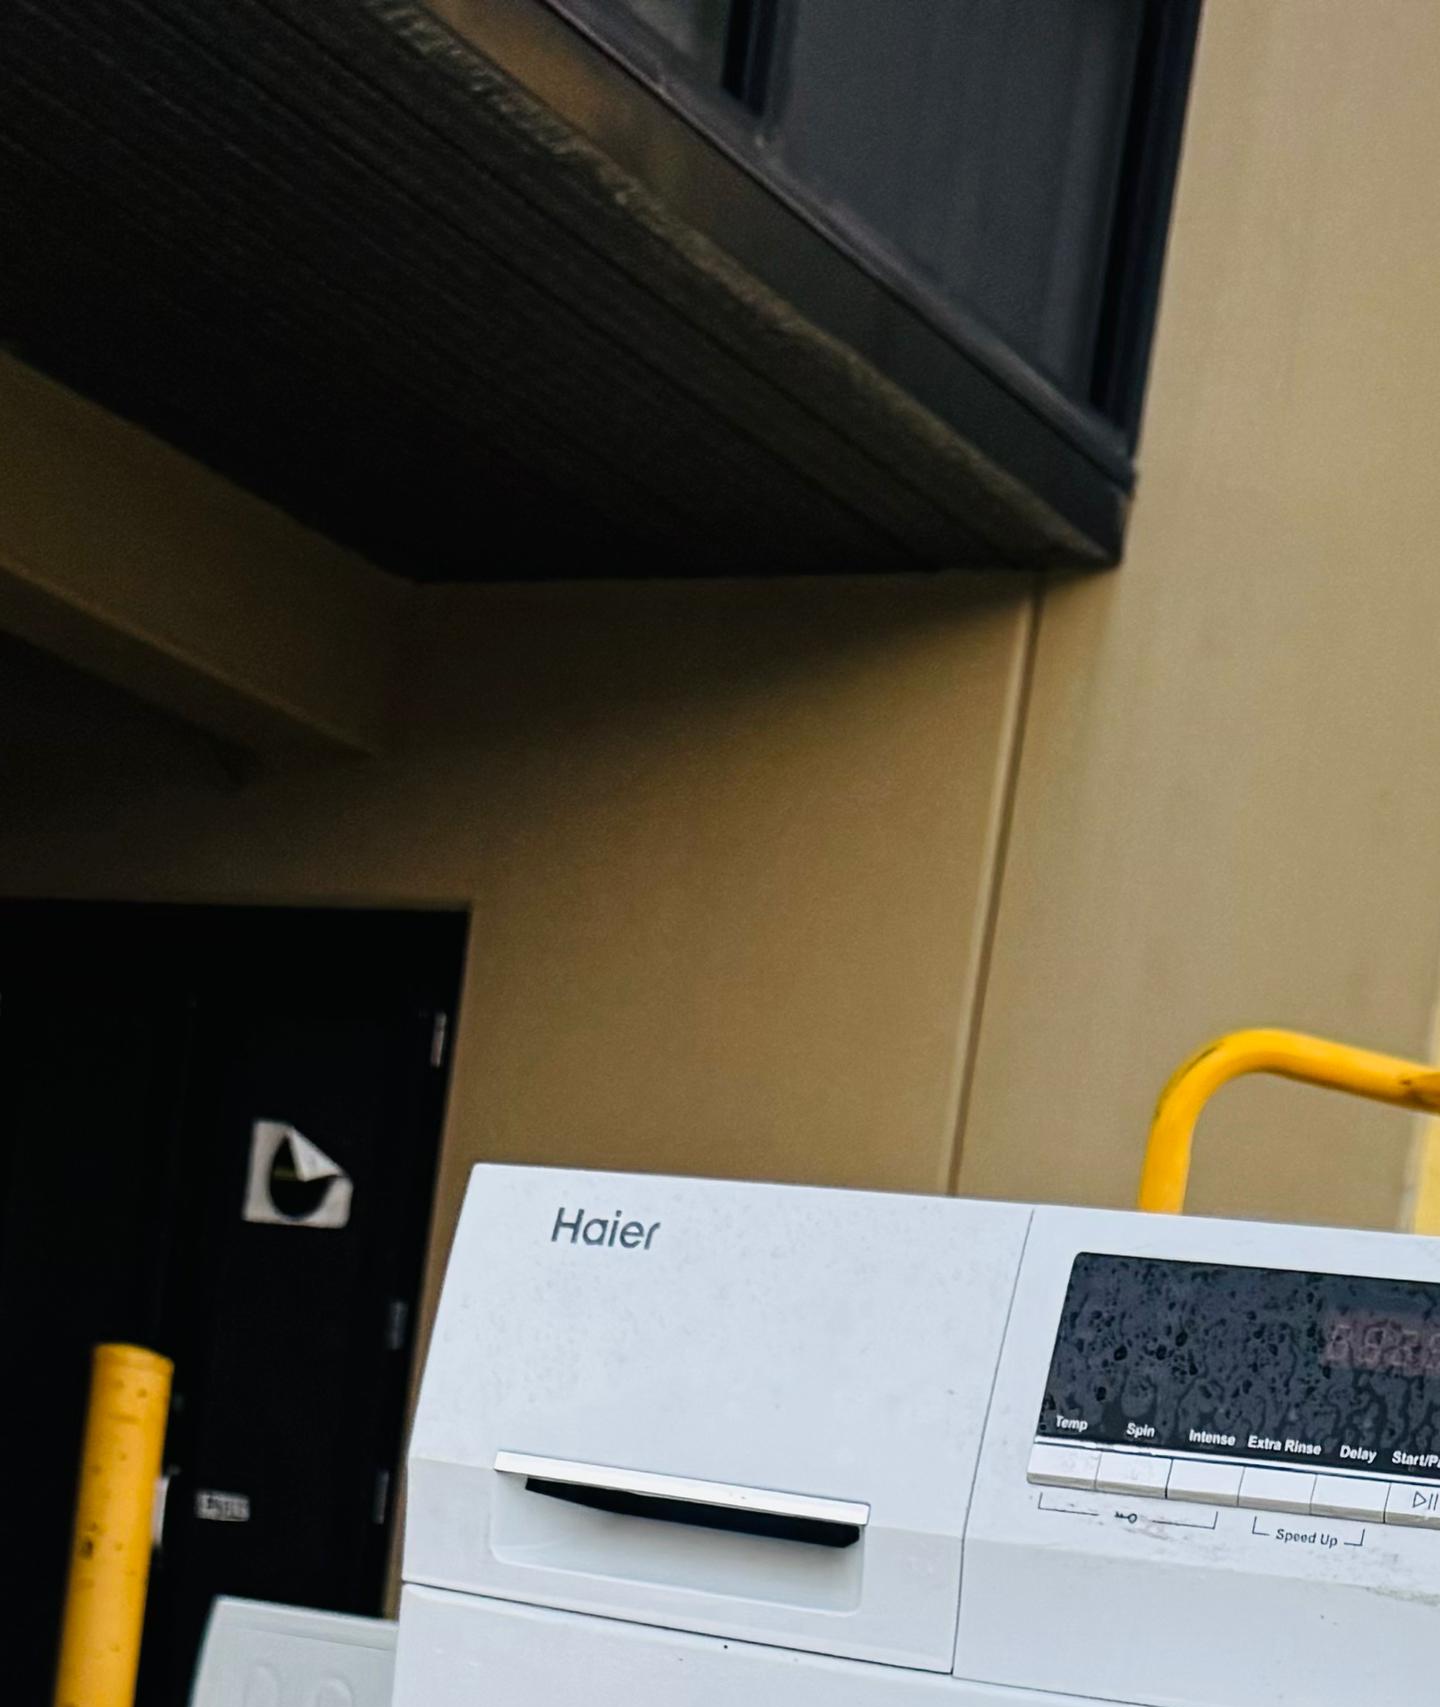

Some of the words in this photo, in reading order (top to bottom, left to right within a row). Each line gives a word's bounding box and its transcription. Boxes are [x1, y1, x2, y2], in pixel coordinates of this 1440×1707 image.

[551, 1207, 661, 1250] Haier
[1055, 1415, 1088, 1432] Temp
[1126, 1423, 1155, 1439] Spin
[1189, 1429, 1236, 1447] Intense
[1248, 1435, 1281, 1451] Extra
[1284, 1439, 1322, 1455] Rinse
[1339, 1445, 1377, 1464] Delay
[1275, 1528, 1316, 1545] Speed
[1320, 1531, 1338, 1548] Up
